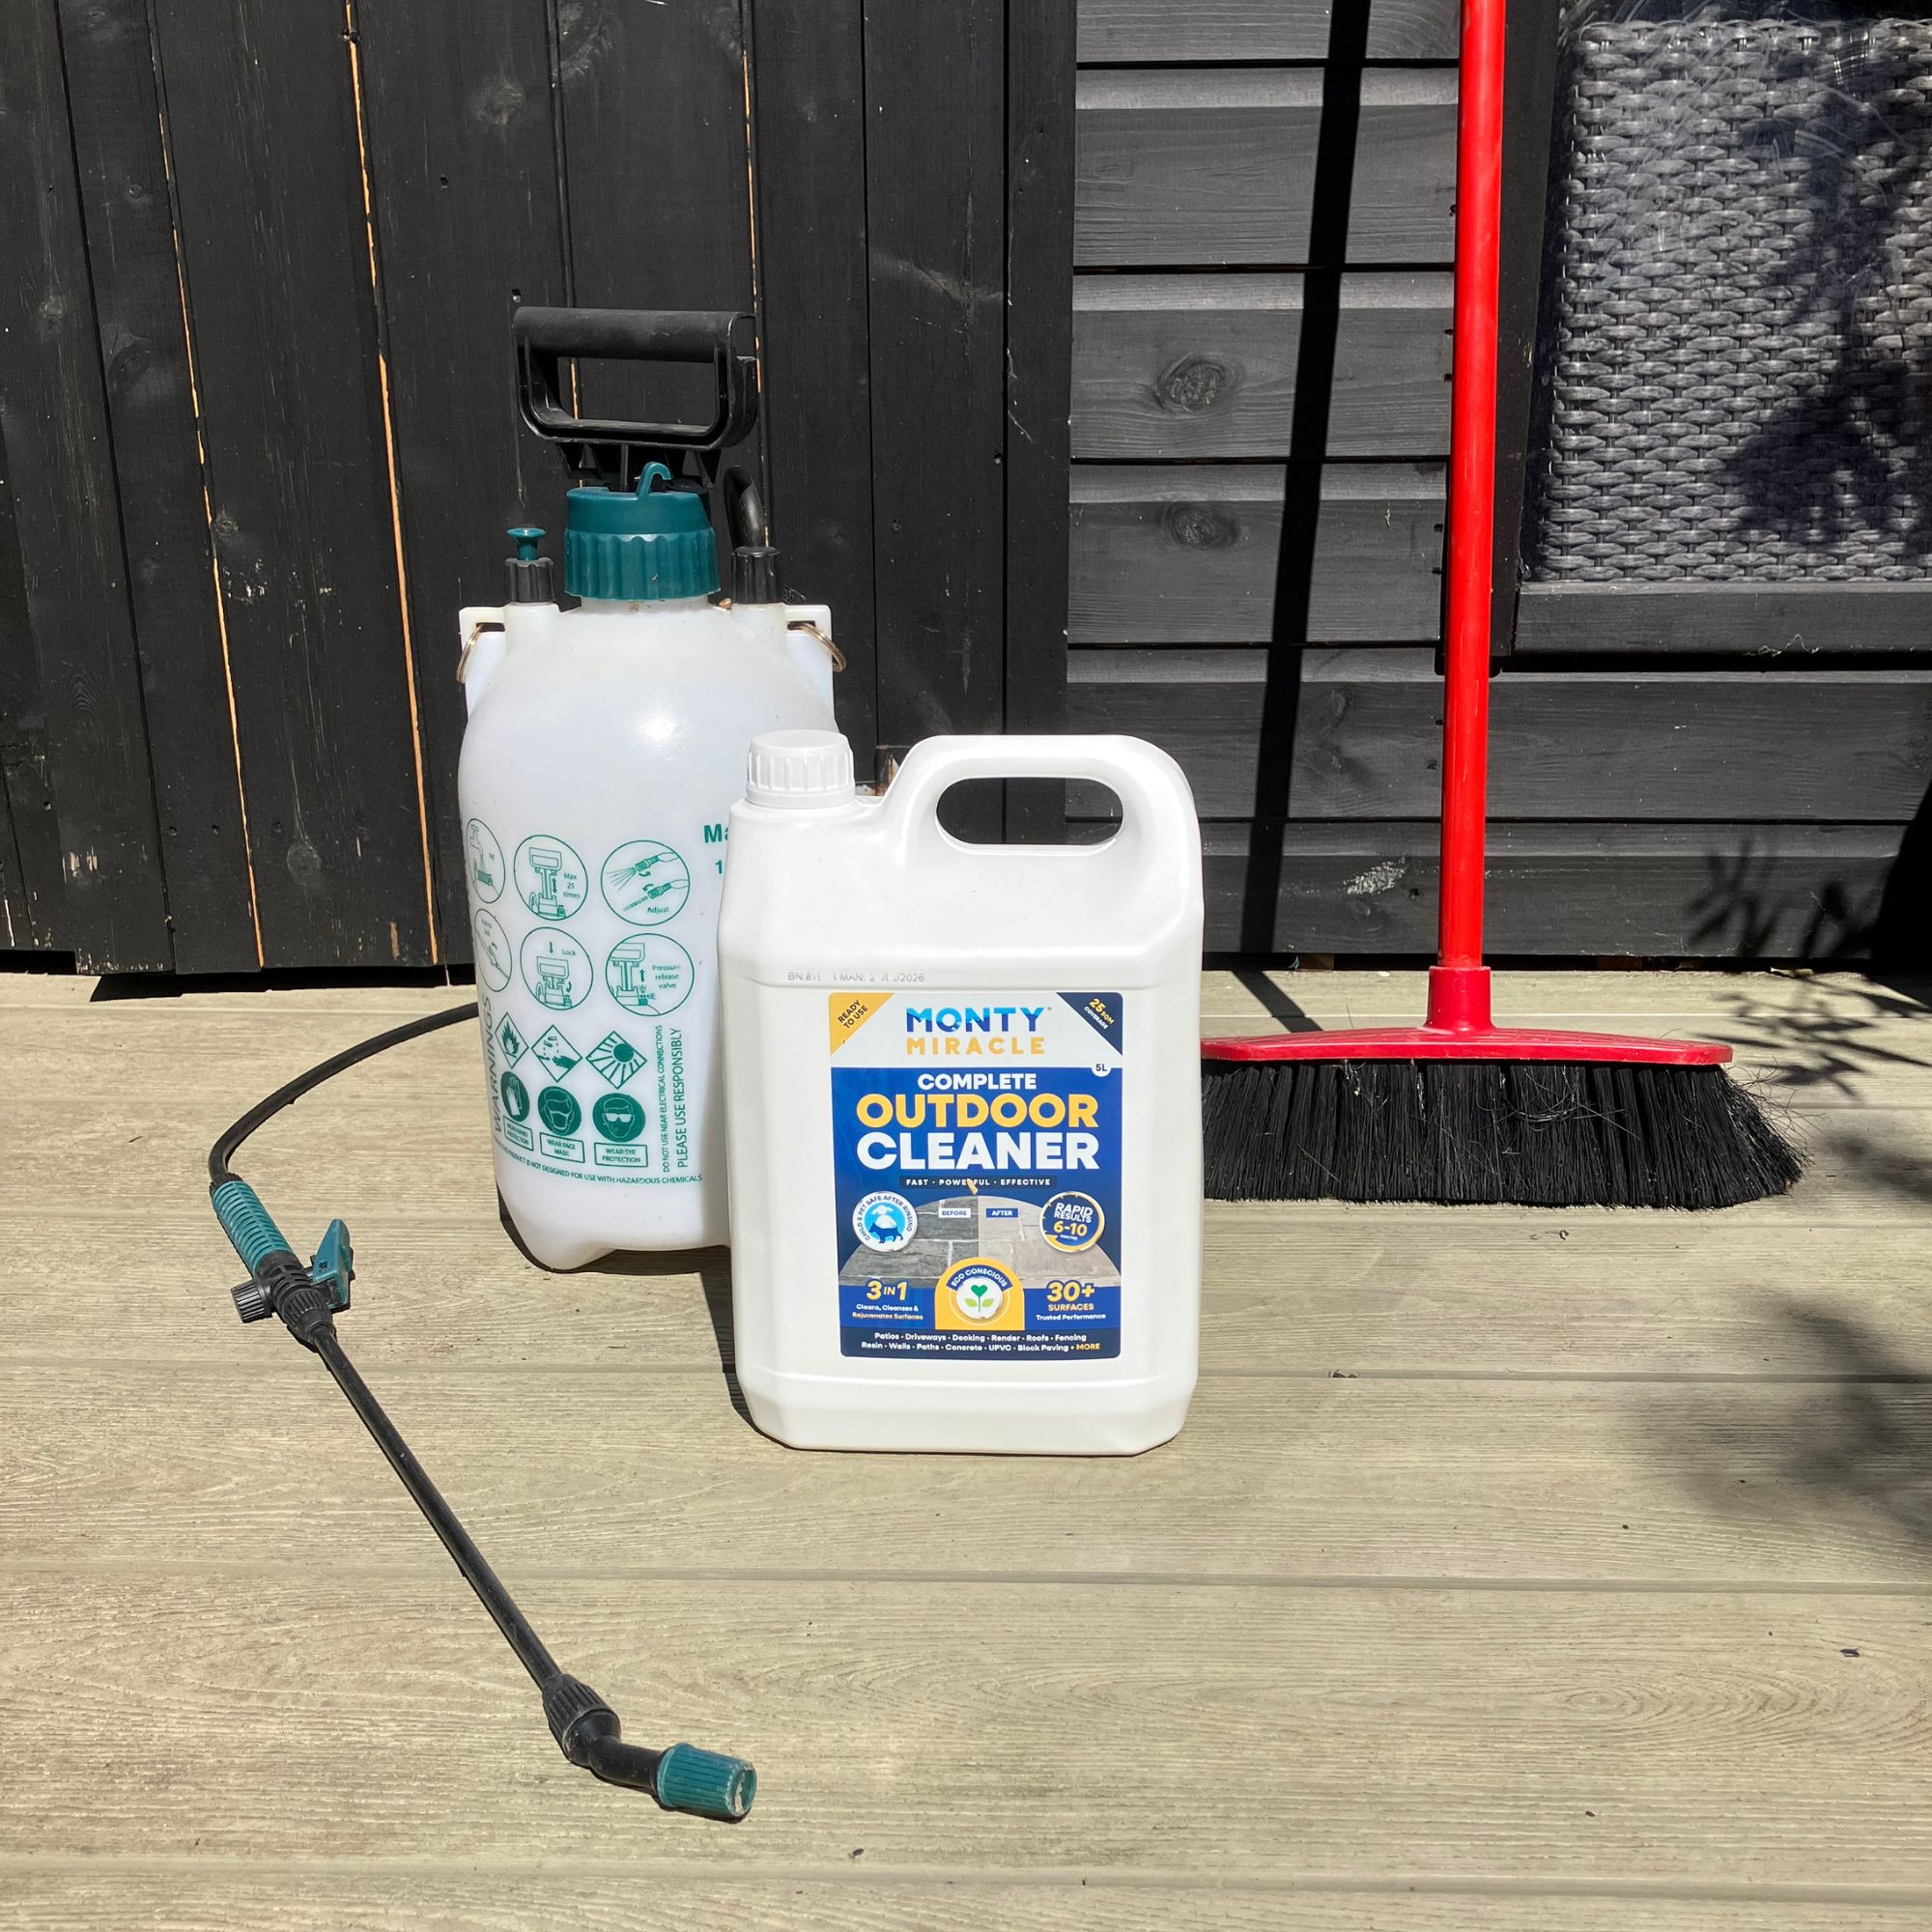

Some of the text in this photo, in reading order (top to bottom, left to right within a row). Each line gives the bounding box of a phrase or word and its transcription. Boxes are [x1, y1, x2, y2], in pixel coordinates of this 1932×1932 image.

[647, 906, 669, 915] Adjust
[838, 999, 861, 1023] READY
[843, 1005, 868, 1029] TO USE
[905, 1007, 1045, 1033] MONTY
[1084, 1006, 1109, 1030] COVERAGE
[655, 1024, 665, 1073] CONNECTIONS
[905, 1037, 1046, 1056] MIRACLE
[1095, 1064, 1108, 1072] 5L
[918, 1073, 1037, 1090] COMPLETE
[658, 1074, 668, 1113] ELECTRICAL
[670, 1028, 688, 1167] PLEASE USE RESPONSIBLY
[856, 1093, 1099, 1128] OUTDOOR
[856, 1131, 1100, 1170] CLEANER
[542, 1164, 570, 1176] DESIGNED
[570, 1171, 583, 1179] FOR
[584, 1173, 596, 1181] USE
[662, 1175, 703, 1184] CHEMICALS
[663, 1161, 669, 1173] DO
[858, 1204, 867, 1215] PET
[866, 1195, 882, 1206] SAFE
[883, 1195, 904, 1207] AFTER
[1055, 1202, 1094, 1217] RAPID
[902, 1205, 913, 1232] RINSING
[1054, 1210, 1093, 1224] RESULTS
[857, 1222, 870, 1241] CHILD
[1053, 1220, 1088, 1236] 6-10
[951, 1267, 1008, 1287] ECO CONSCIOUS
[866, 1280, 907, 1301] 3 IN 1
[1046, 1281, 1095, 1302] 30+
[1048, 1303, 1094, 1312] SURFACES
[905, 1333, 947, 1342] Driveways
[952, 1334, 985, 1343] Decking
[1041, 1344, 1069, 1352] Paving
